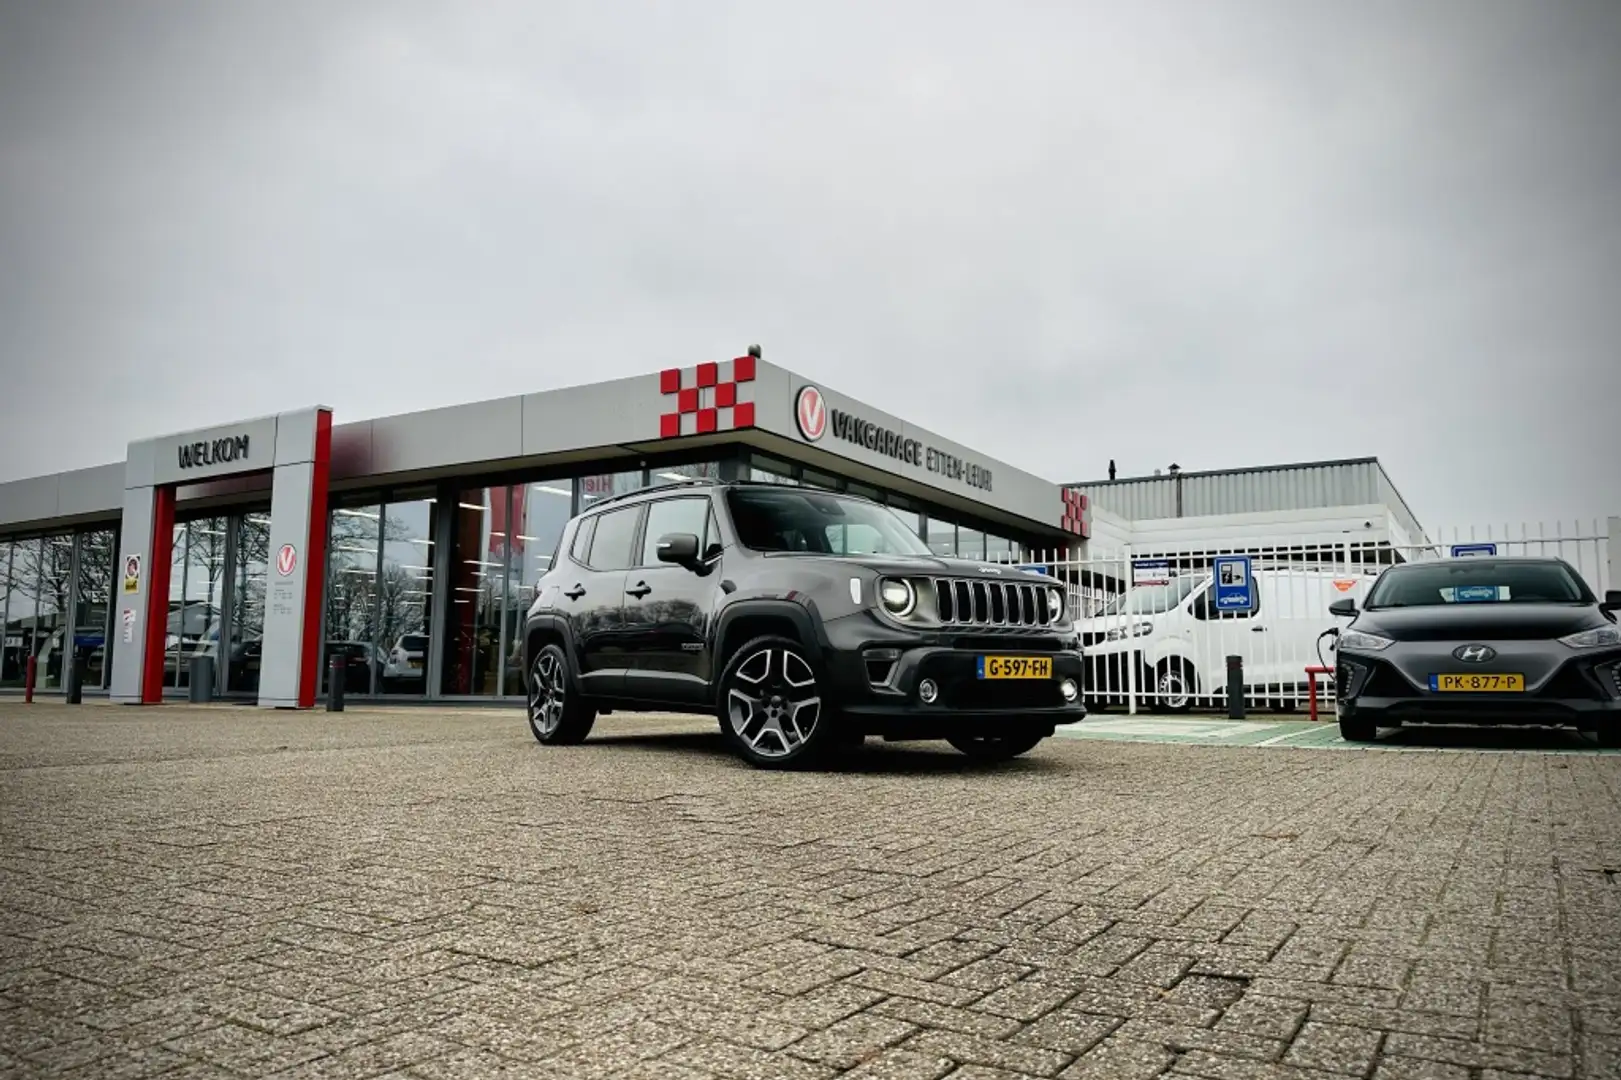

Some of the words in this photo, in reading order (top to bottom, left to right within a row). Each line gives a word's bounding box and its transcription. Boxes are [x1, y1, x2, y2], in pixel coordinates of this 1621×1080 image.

[831, 408, 922, 467] VAKGARAGE
[178, 434, 250, 470] WELKOM
[989, 658, 1048, 677] G-597-FH
[1444, 676, 1517, 689] PK-877-P
